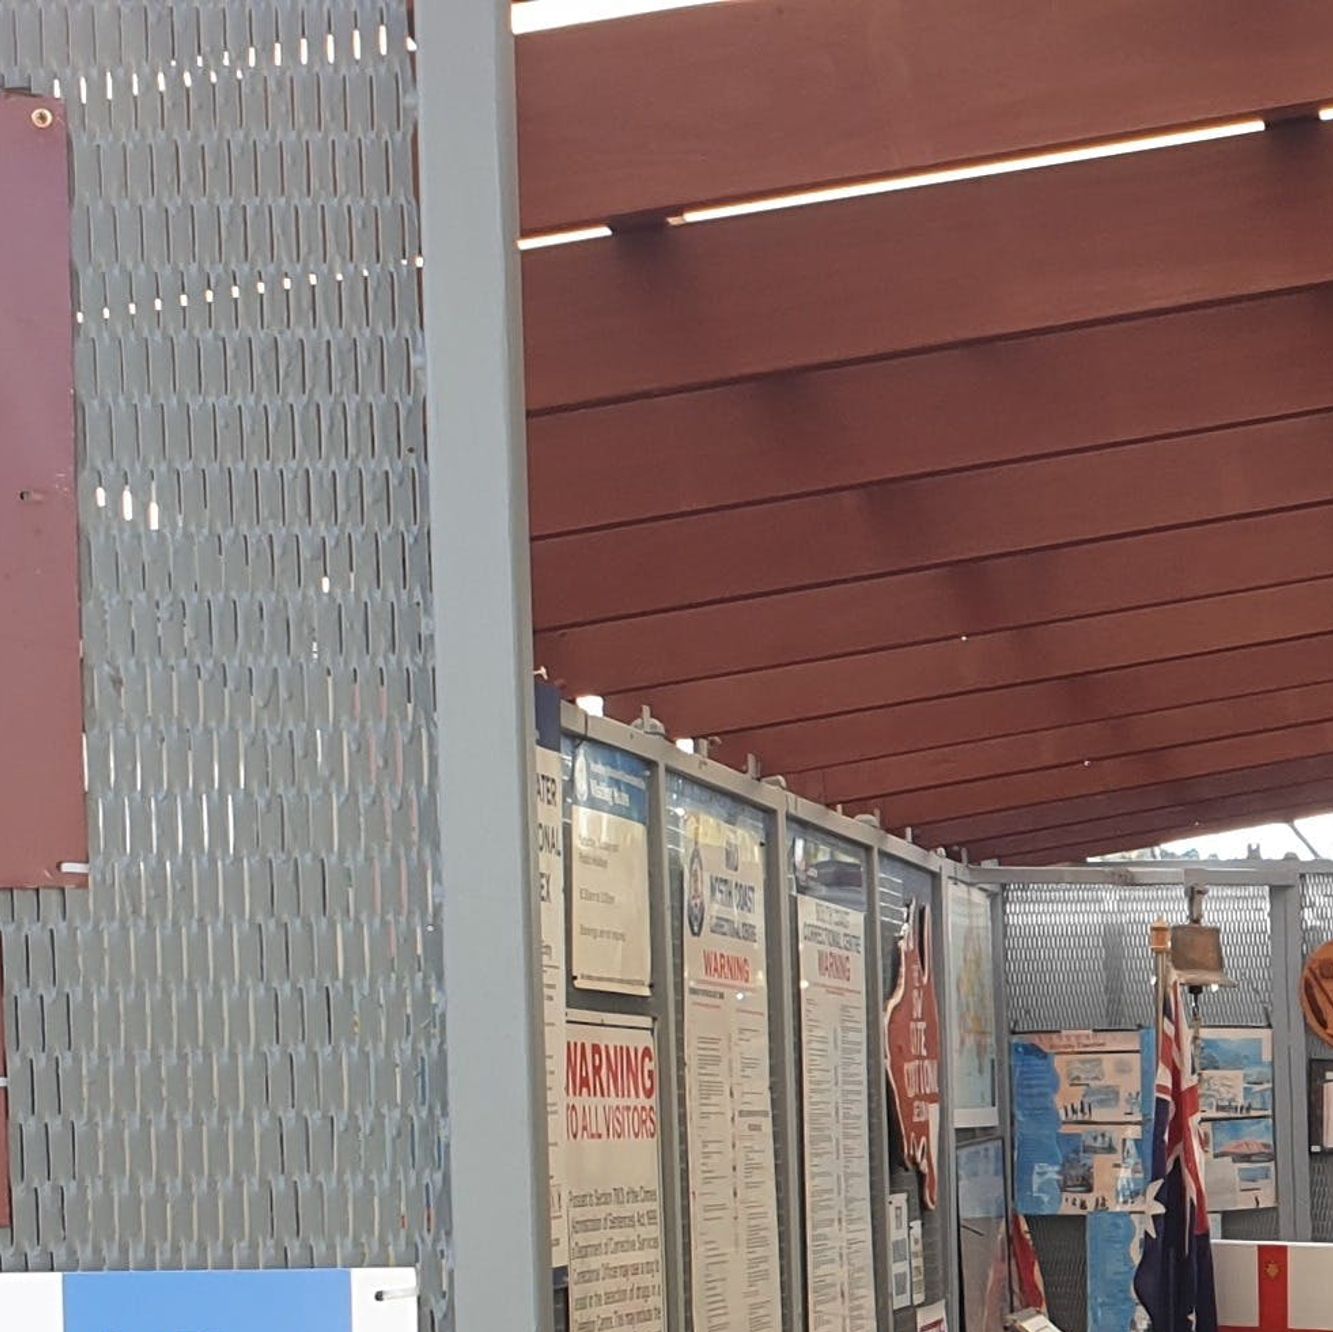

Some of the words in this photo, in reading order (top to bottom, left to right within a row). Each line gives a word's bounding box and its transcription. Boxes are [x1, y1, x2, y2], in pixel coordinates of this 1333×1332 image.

[703, 949, 750, 983] WARNING
[817, 949, 851, 982] WARNING
[566, 1040, 655, 1098] WARNING
[582, 1105, 603, 1139] ALL
[604, 1105, 656, 1140] VISITORS
